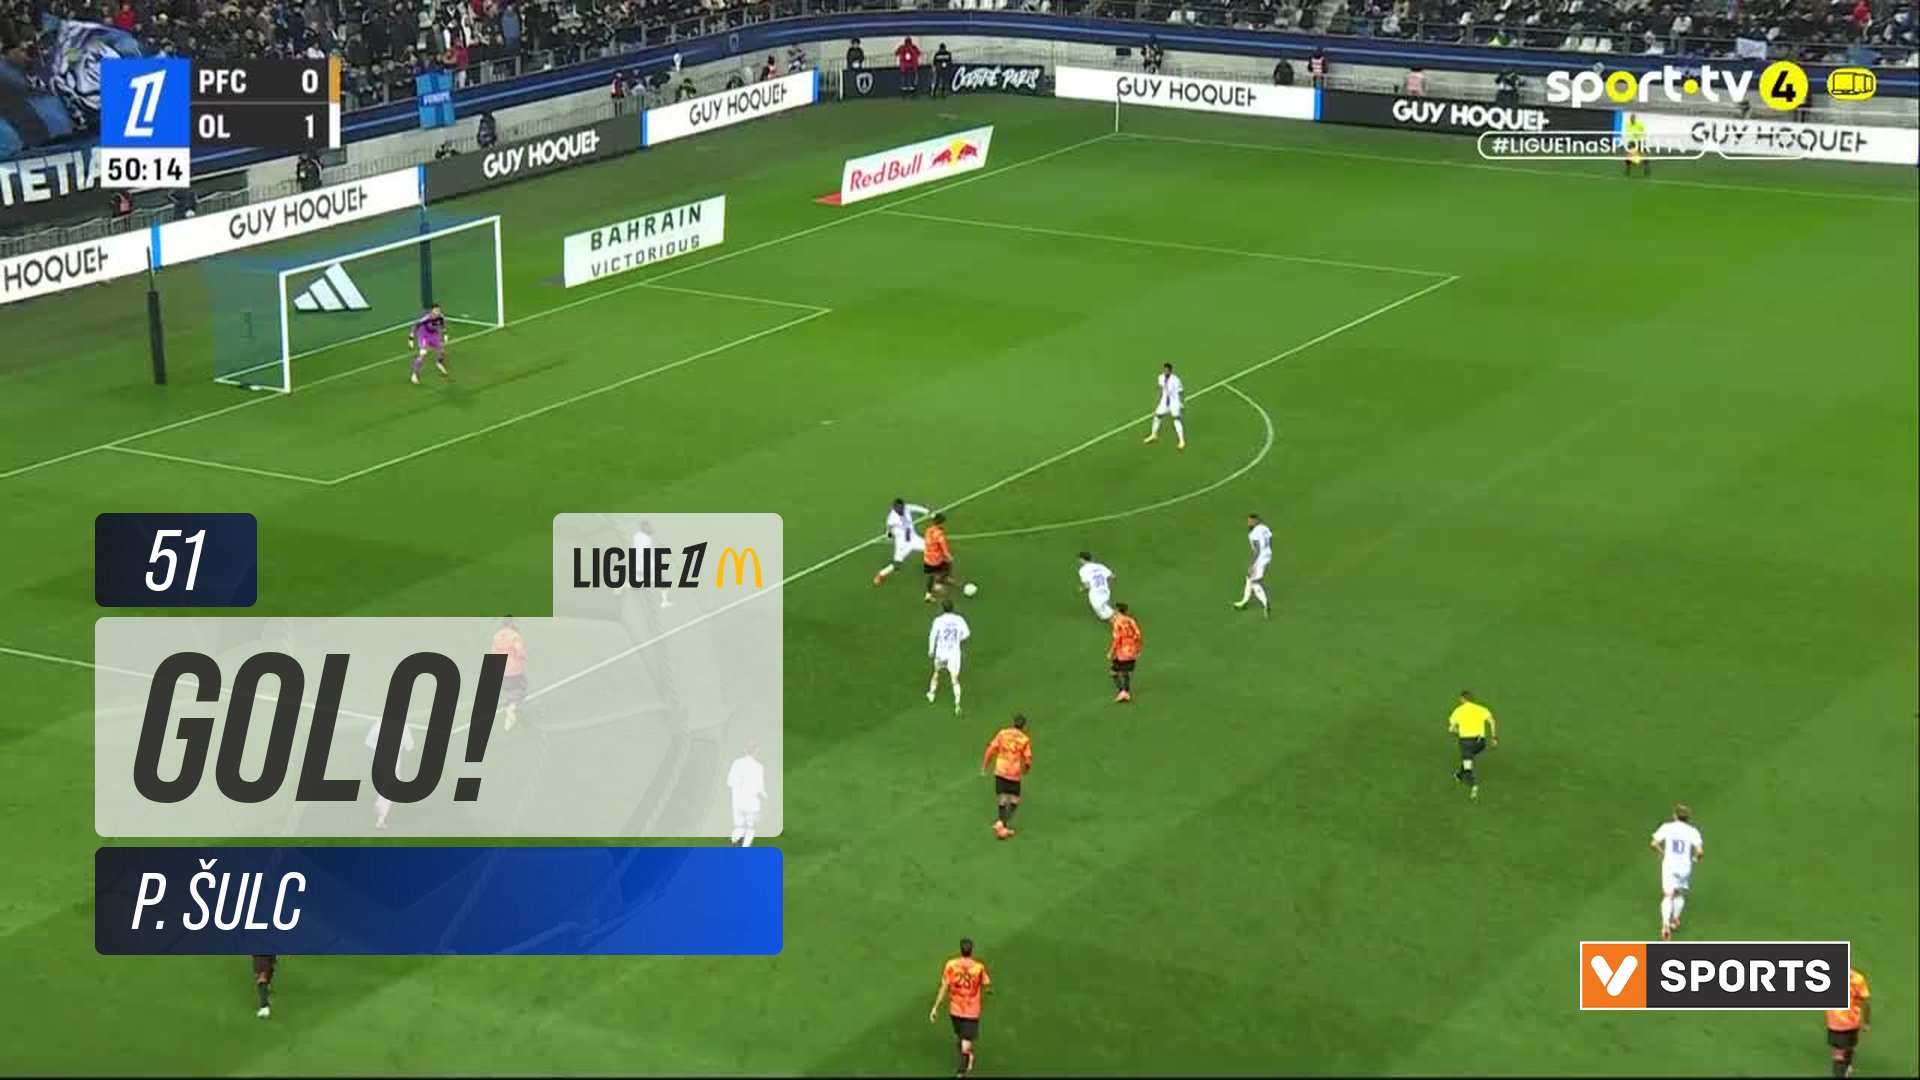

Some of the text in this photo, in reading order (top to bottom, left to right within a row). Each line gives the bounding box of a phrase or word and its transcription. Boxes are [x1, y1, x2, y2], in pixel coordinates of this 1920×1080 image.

[689, 84, 788, 127] GUY HOQUET
[1116, 76, 1258, 107] GUY HOQUET
[1393, 99, 1550, 131] GUY HOQUET
[1691, 121, 1751, 147] GUY
[483, 129, 601, 180] GUY HOQUET
[229, 186, 368, 240] GUY HOQUET
[590, 203, 703, 252] BAHRAIN
[4, 246, 109, 293] HOQUET
[590, 234, 701, 279] VICTORIOUS
[1671, 839, 1686, 854] 10
[954, 971, 972, 991] 28
